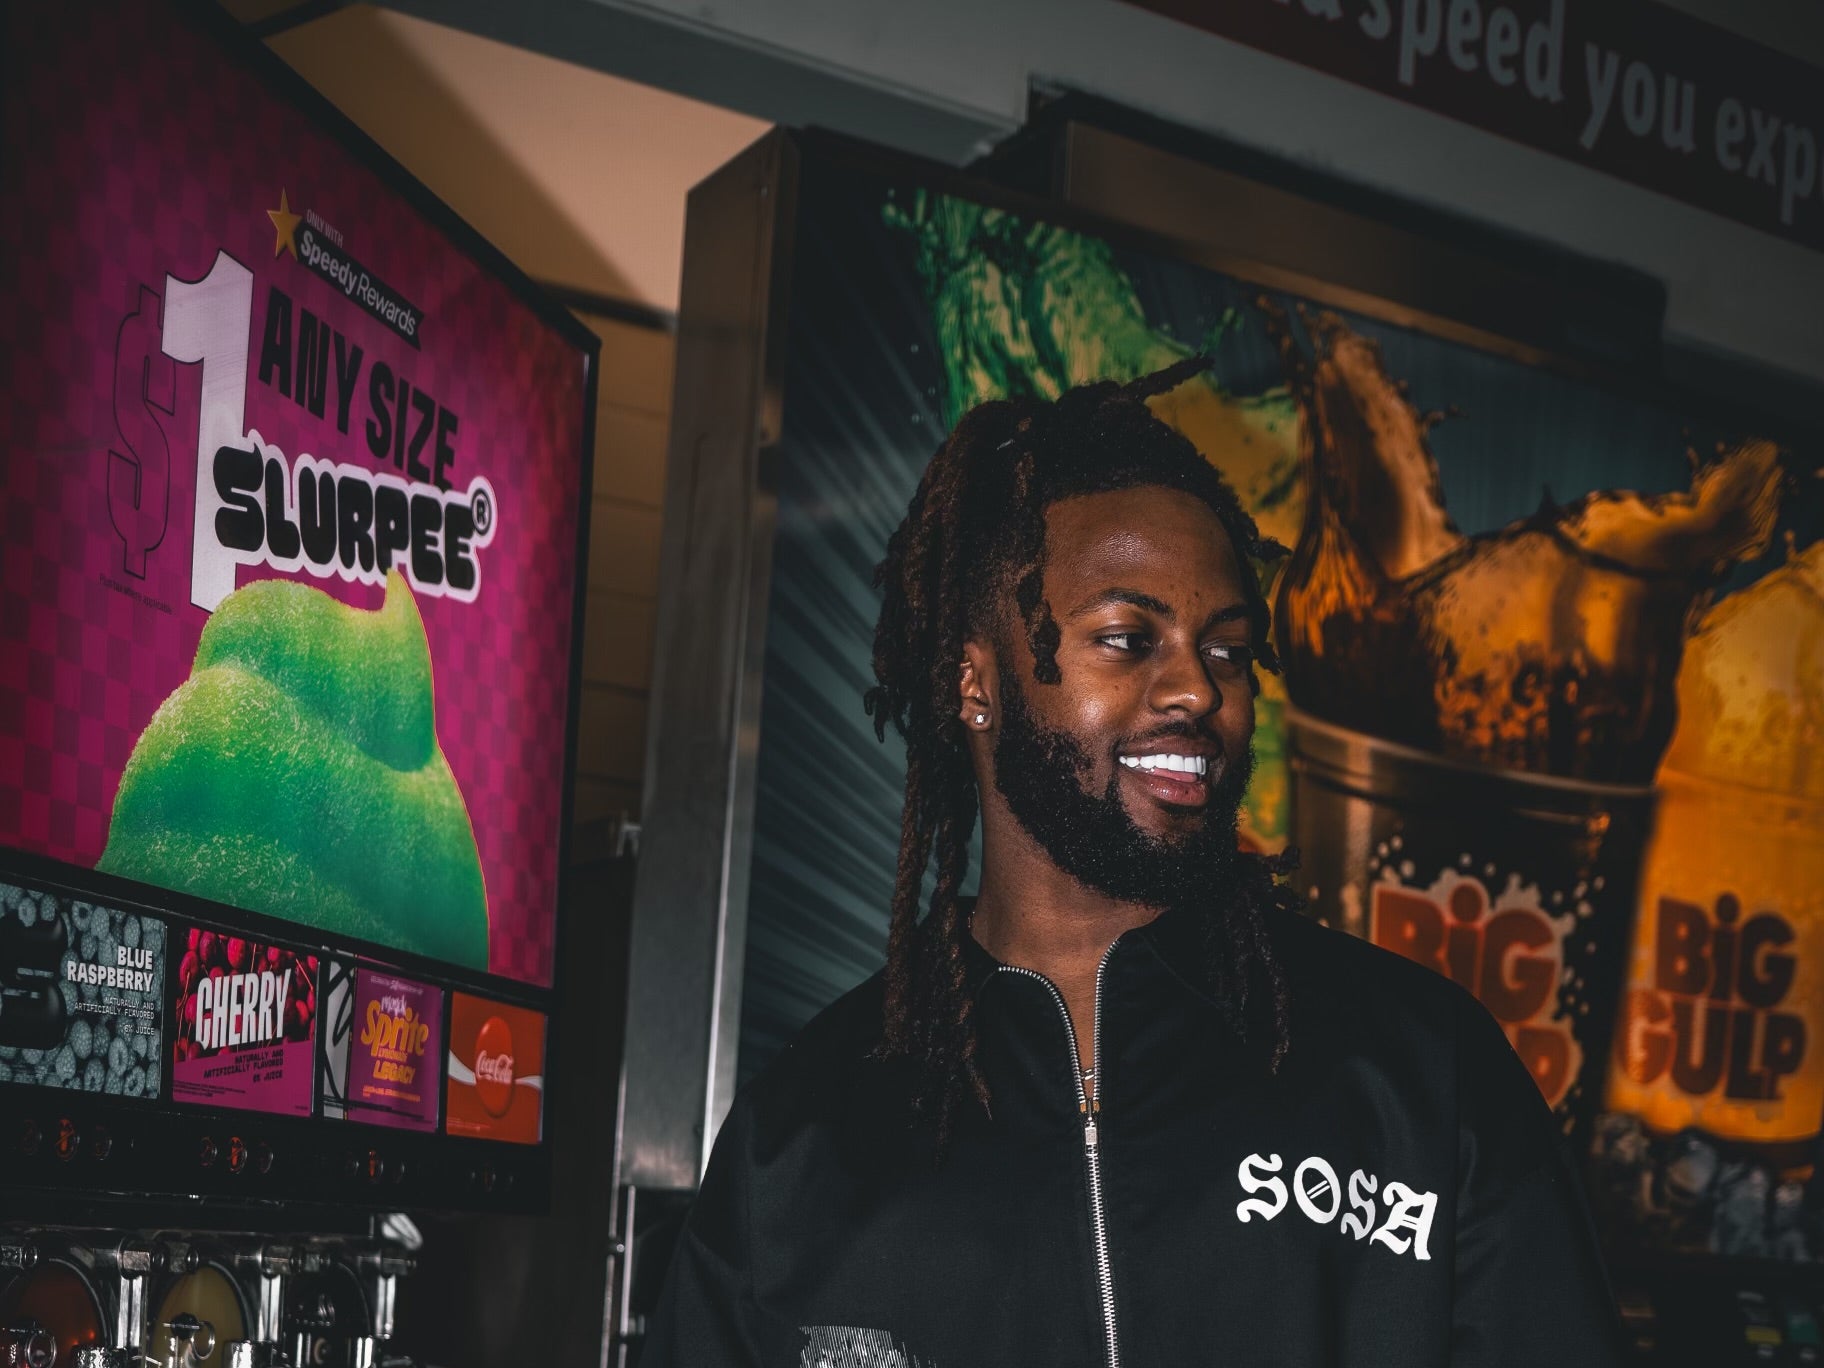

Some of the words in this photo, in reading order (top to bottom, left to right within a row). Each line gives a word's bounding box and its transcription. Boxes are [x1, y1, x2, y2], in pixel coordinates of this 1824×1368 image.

[1580, 42, 1697, 153] you
[1715, 97, 1824, 226] exp
[306, 208, 325, 233] ONLY
[325, 222, 344, 248] WITH
[259, 286, 363, 435] ANY
[366, 361, 458, 491] SIZE
[117, 945, 154, 971] BLUE
[67, 960, 154, 993] RASPBERRY
[74, 1002, 121, 1016] ARTIFICIALLY
[124, 1008, 155, 1020] FLAVORED
[105, 996, 140, 1008] NATURALLY
[142, 1002, 155, 1011] AND
[195, 968, 292, 1050] CHERRY
[136, 1026, 155, 1036] JUICE
[360, 1000, 429, 1057] Sprite
[1616, 990, 1807, 1100] GULP
[203, 1063, 250, 1079] ARTIFICIALLY
[235, 1051, 269, 1064] NATURALLY
